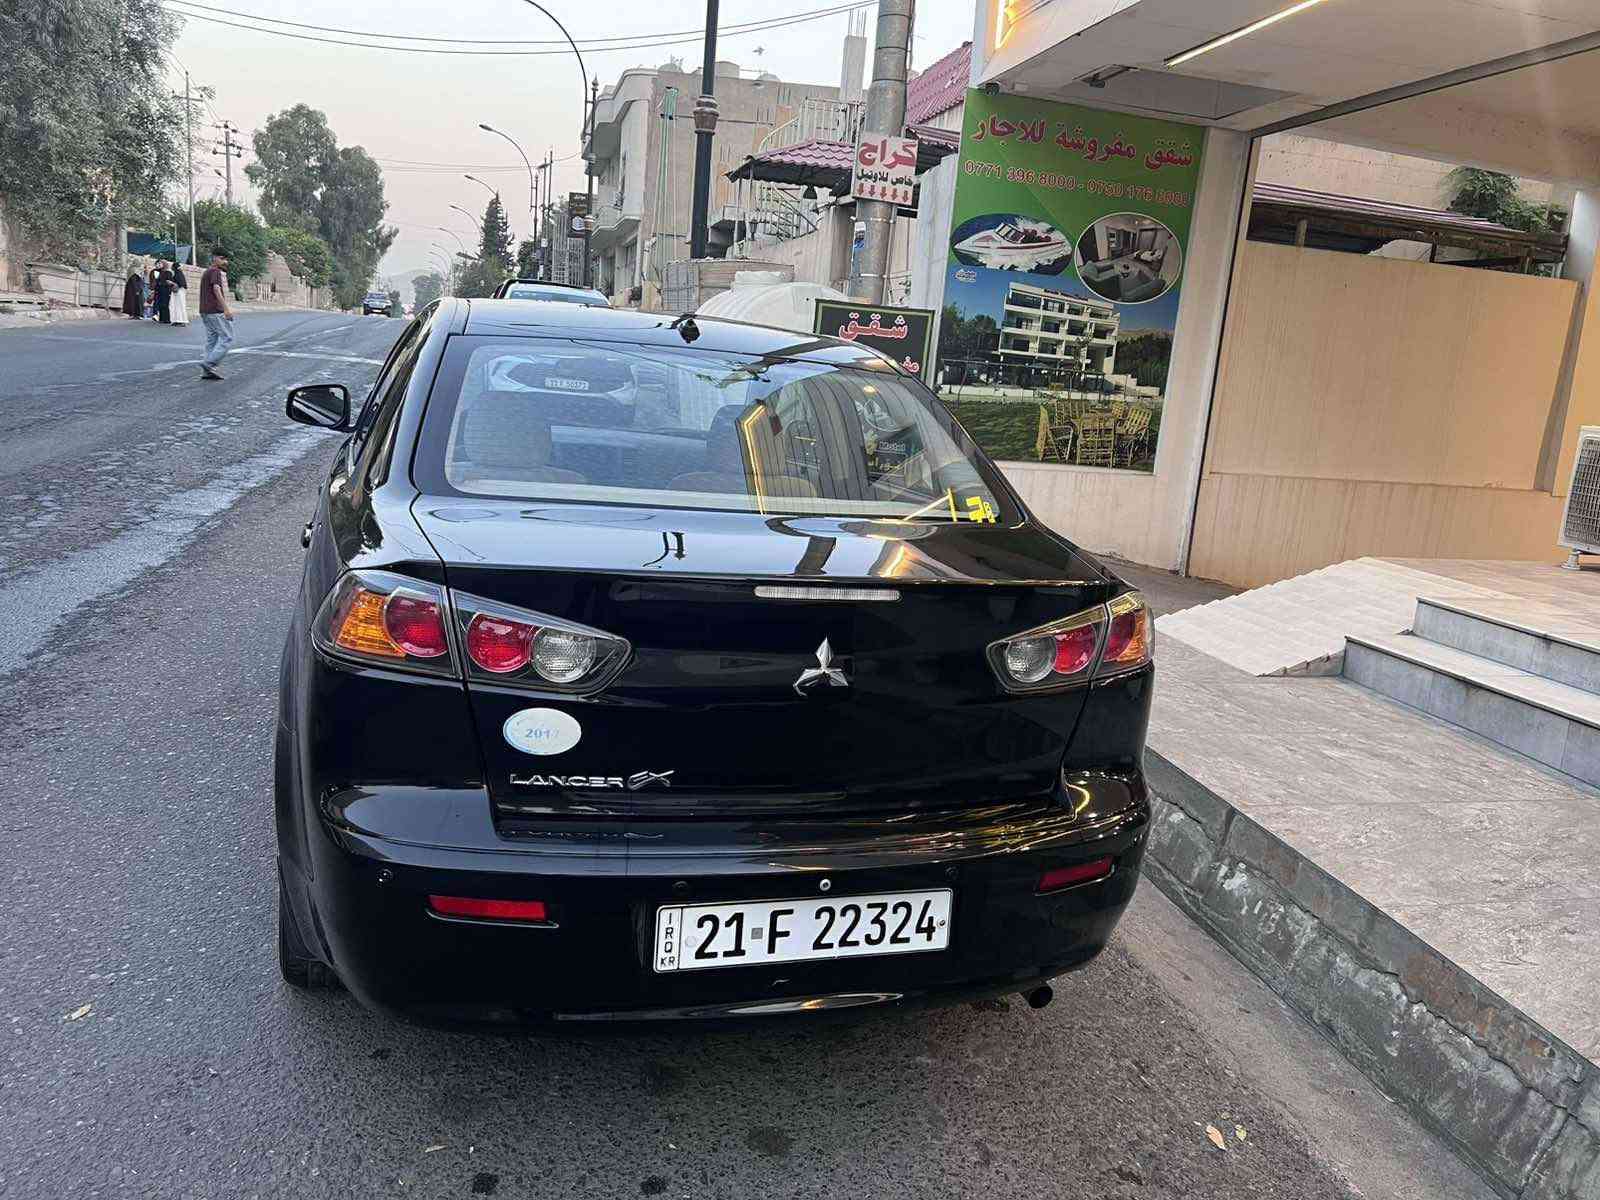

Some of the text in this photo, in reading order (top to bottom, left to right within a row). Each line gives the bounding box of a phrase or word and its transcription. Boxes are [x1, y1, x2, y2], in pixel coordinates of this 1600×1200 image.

[858, 139, 917, 169] كراج
[1055, 121, 1137, 161] مفروشة
[1143, 138, 1194, 169] شقق
[891, 174, 914, 187] خاص
[838, 311, 909, 341] شقق
[509, 769, 675, 791] LANCER EX
[694, 899, 937, 960] 21 F 22324
[659, 955, 676, 968] KR
